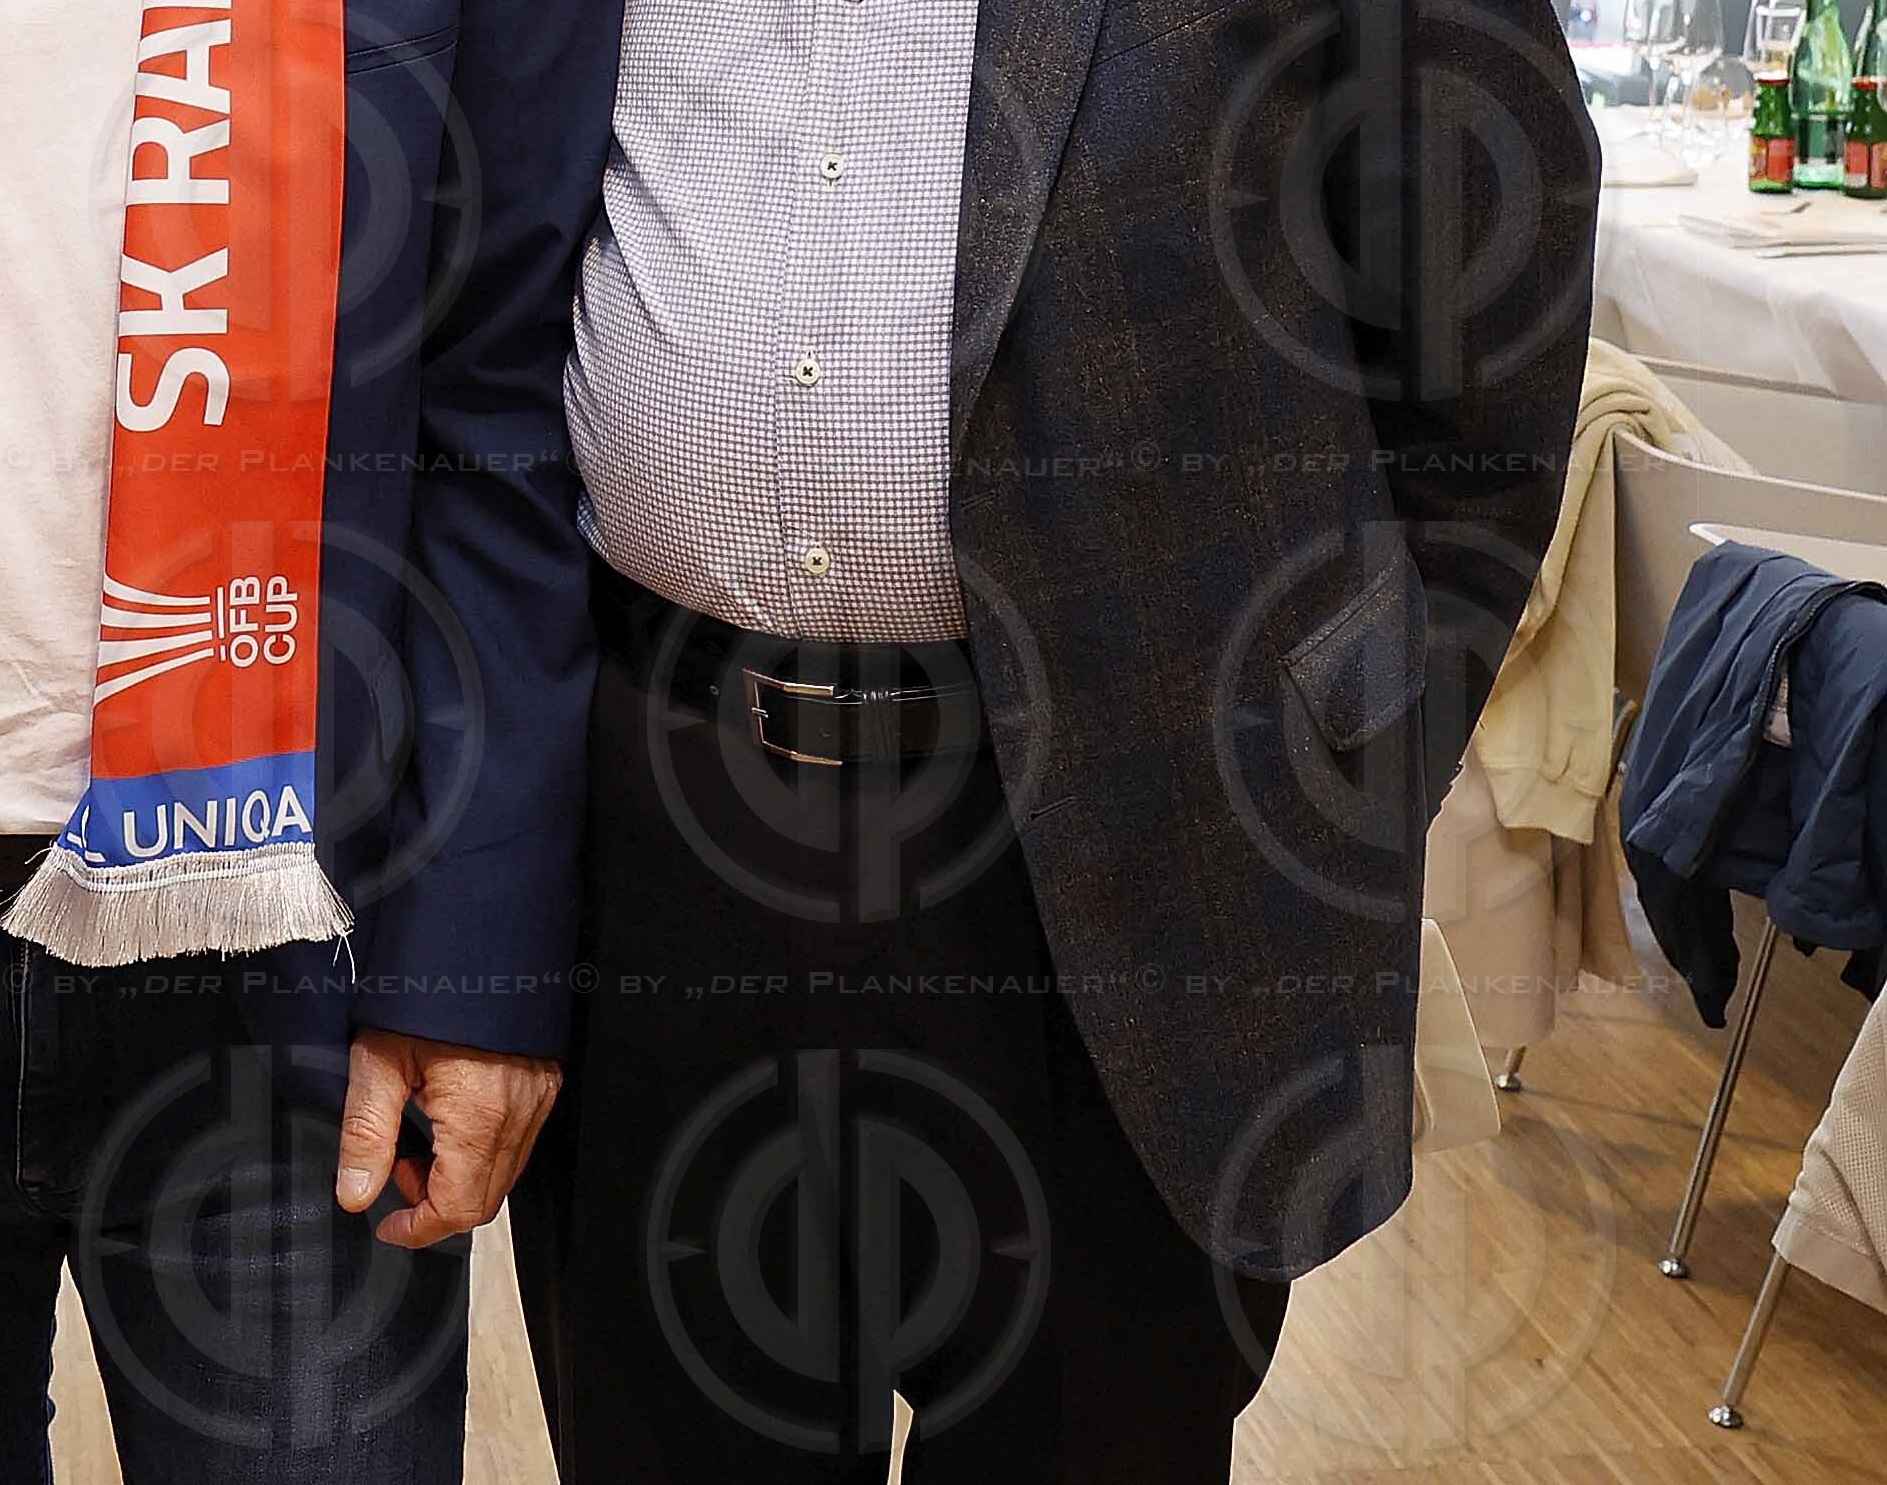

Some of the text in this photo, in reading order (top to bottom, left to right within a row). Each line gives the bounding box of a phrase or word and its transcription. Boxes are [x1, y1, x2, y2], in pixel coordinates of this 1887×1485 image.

[114, 247, 231, 434] SK
[216, 575, 261, 669] ÖFB
[262, 575, 300, 666] CUP
[122, 784, 313, 859] UNIQA
